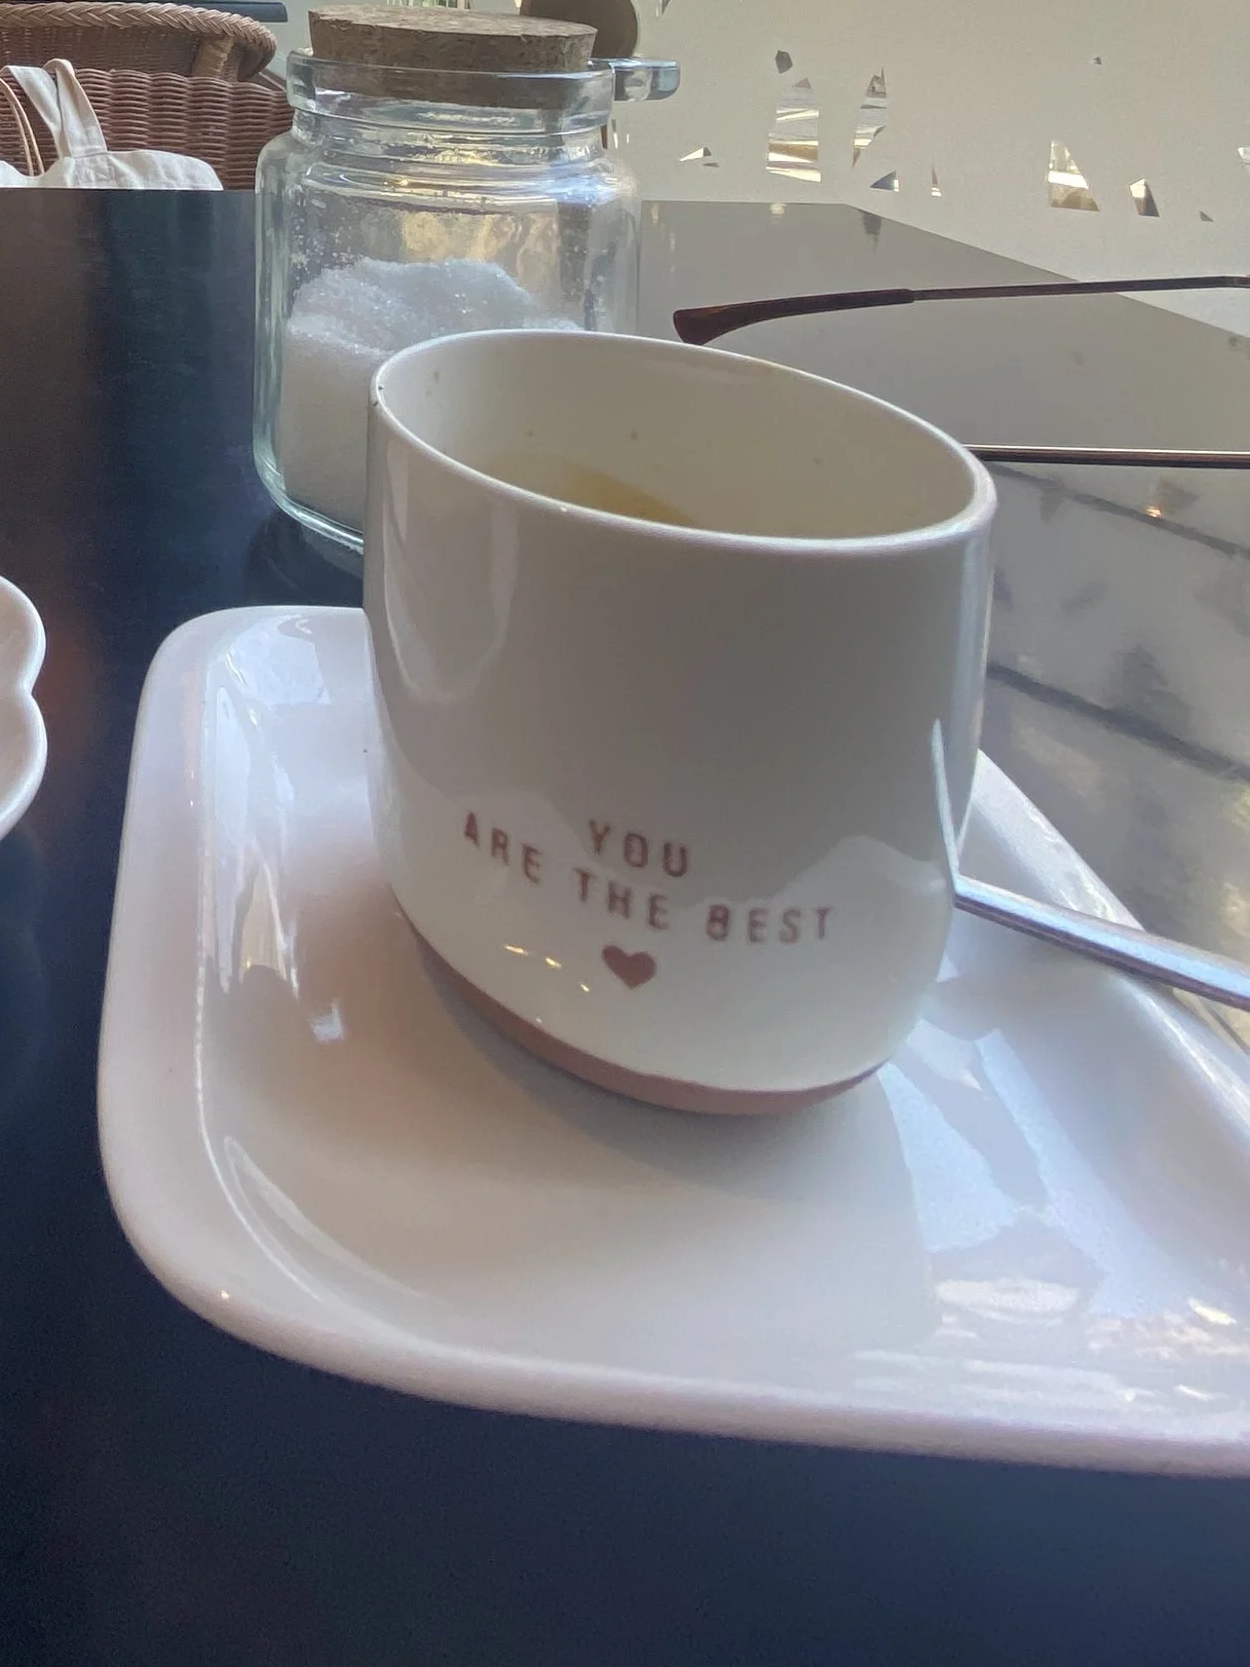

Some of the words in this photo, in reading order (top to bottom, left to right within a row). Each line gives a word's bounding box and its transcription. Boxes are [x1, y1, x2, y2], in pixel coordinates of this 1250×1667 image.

[463, 810, 543, 884] ARE
[573, 867, 671, 931] THE
[705, 903, 834, 944] BEST
[588, 818, 690, 878] YOU
